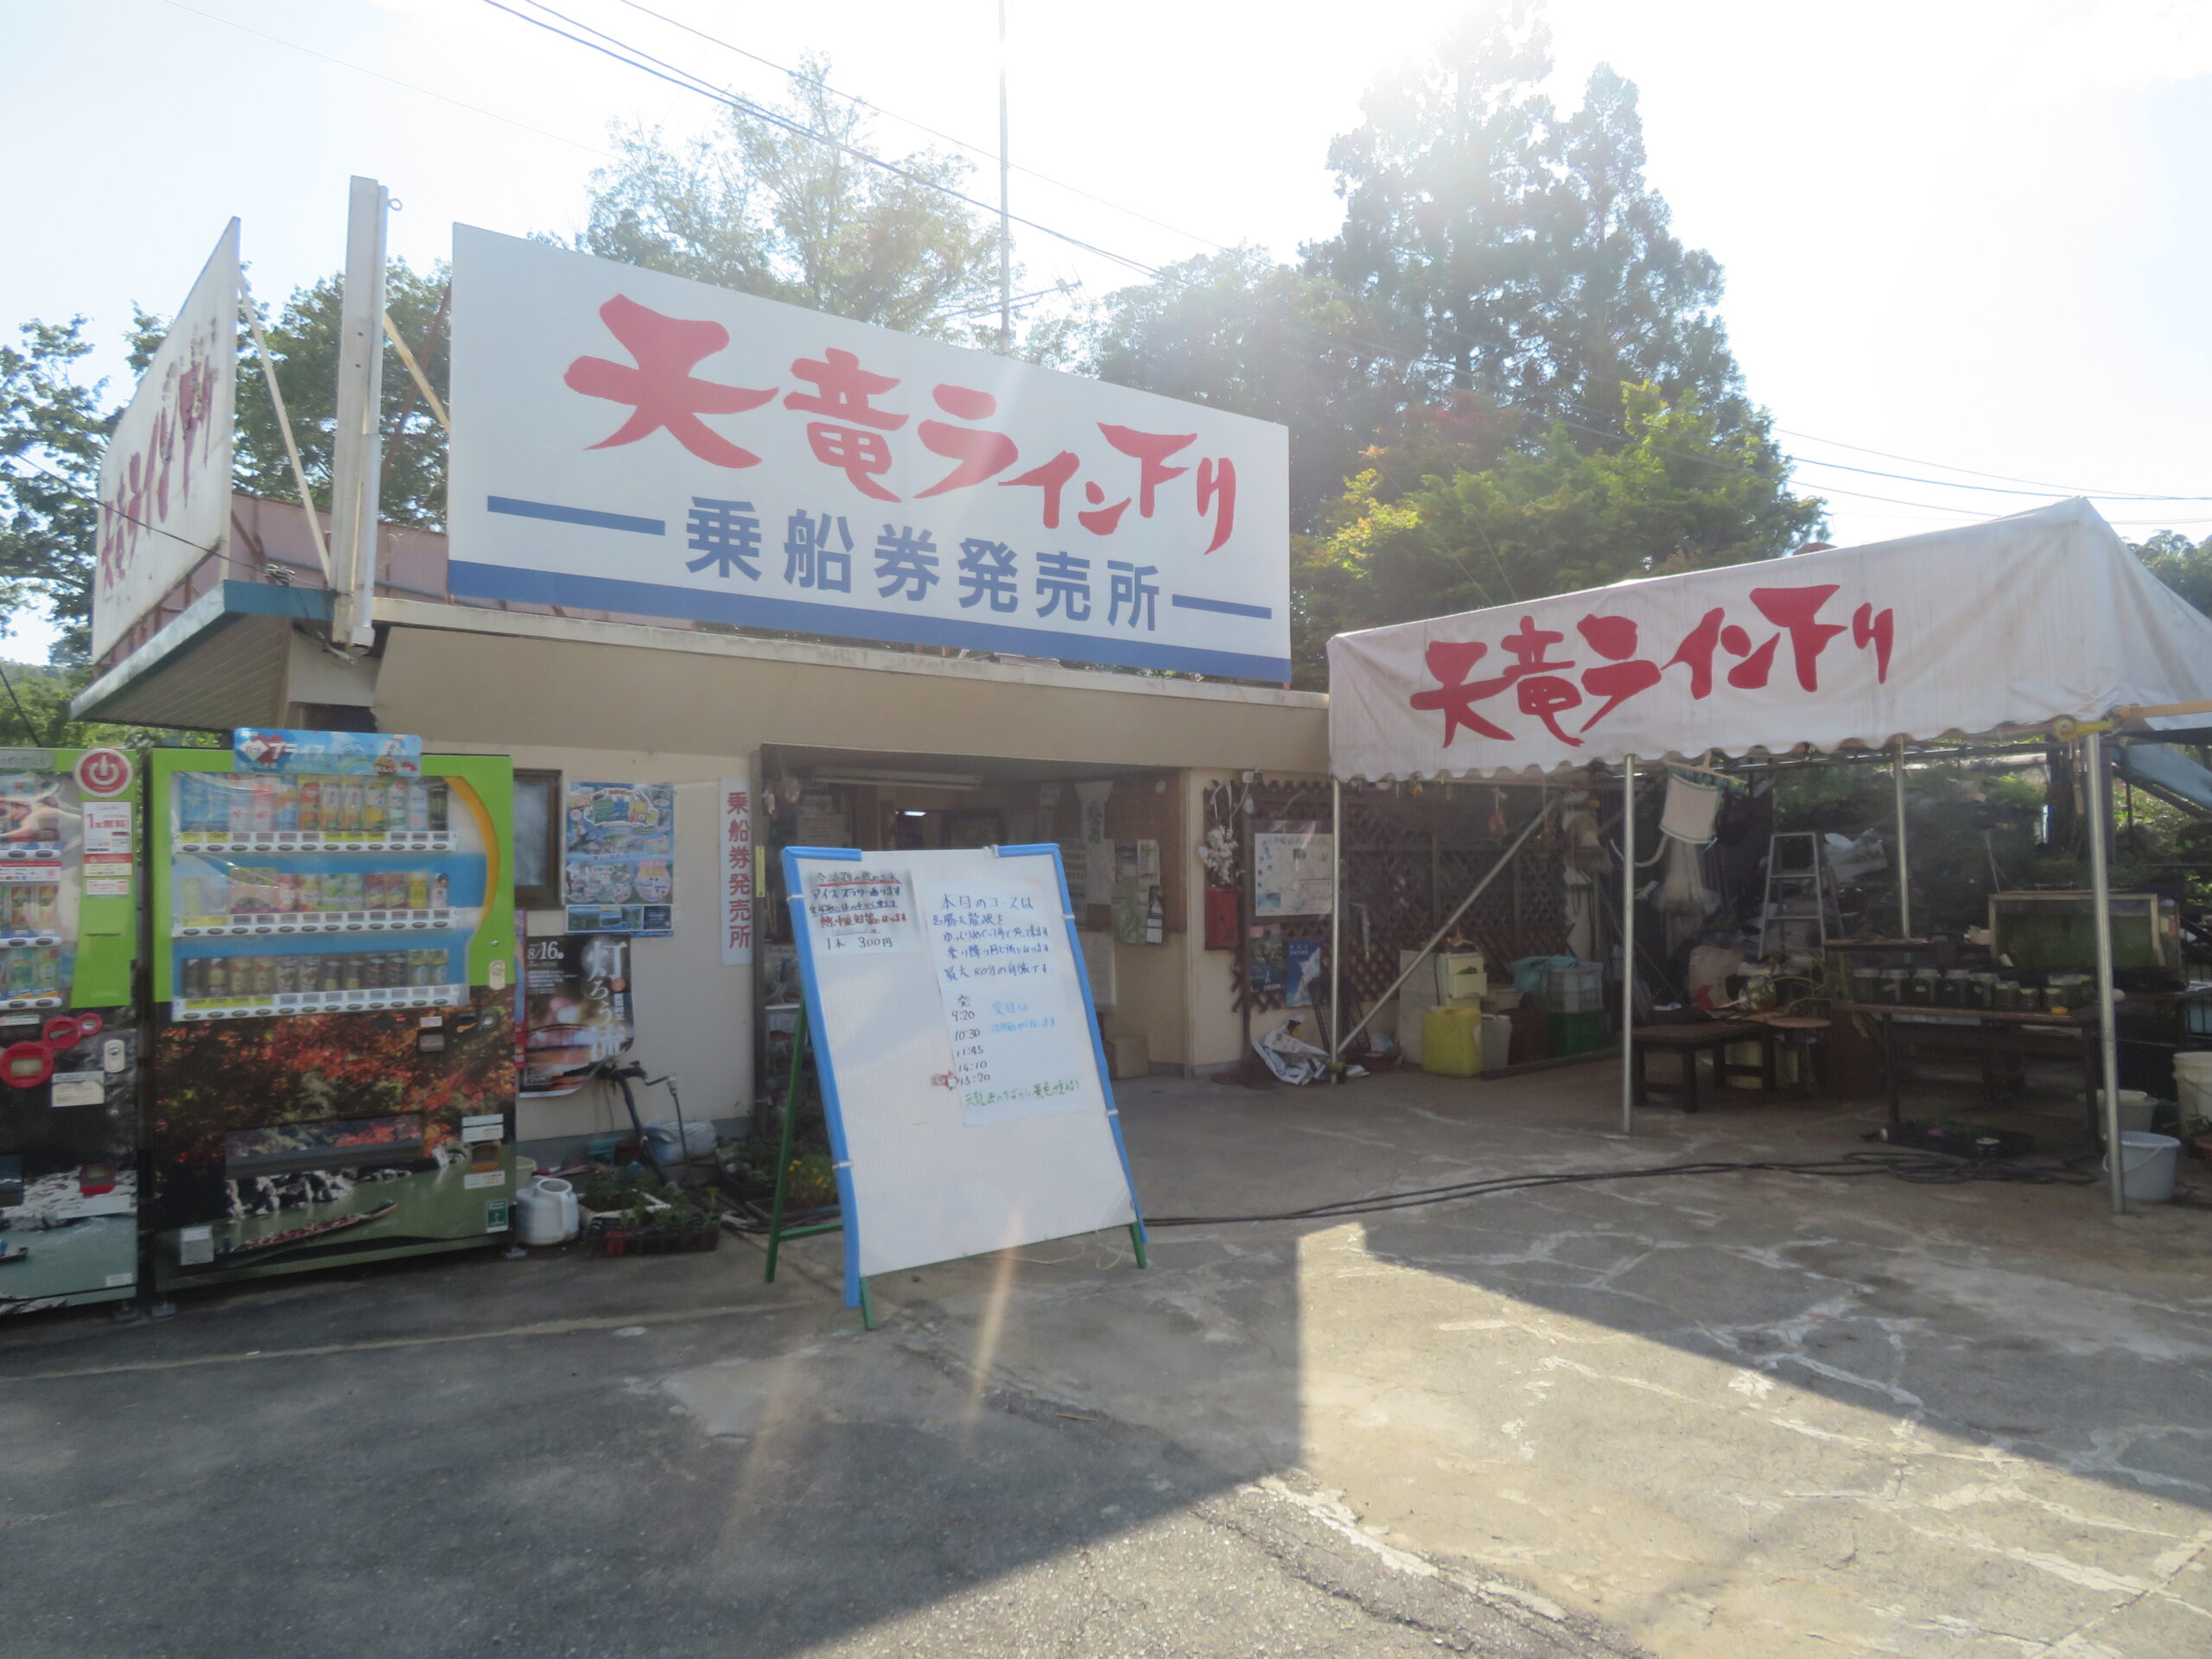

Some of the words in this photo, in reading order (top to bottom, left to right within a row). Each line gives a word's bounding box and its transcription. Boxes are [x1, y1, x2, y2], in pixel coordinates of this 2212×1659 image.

[563, 293, 1236, 555] 天竜ライン下り
[686, 495, 1160, 632] 乗船券発売所
[1410, 584, 1893, 747] 天竜ライン下り
[727, 791, 751, 949] 乗船券発売所
[942, 893, 1033, 910] 本日のコースは
[858, 937, 893, 948] 300円
[951, 1010, 976, 1021] 9:20
[955, 1028, 981, 1041] 10:30
[957, 1045, 984, 1058] 11:45
[959, 1060, 988, 1072] 14:10
